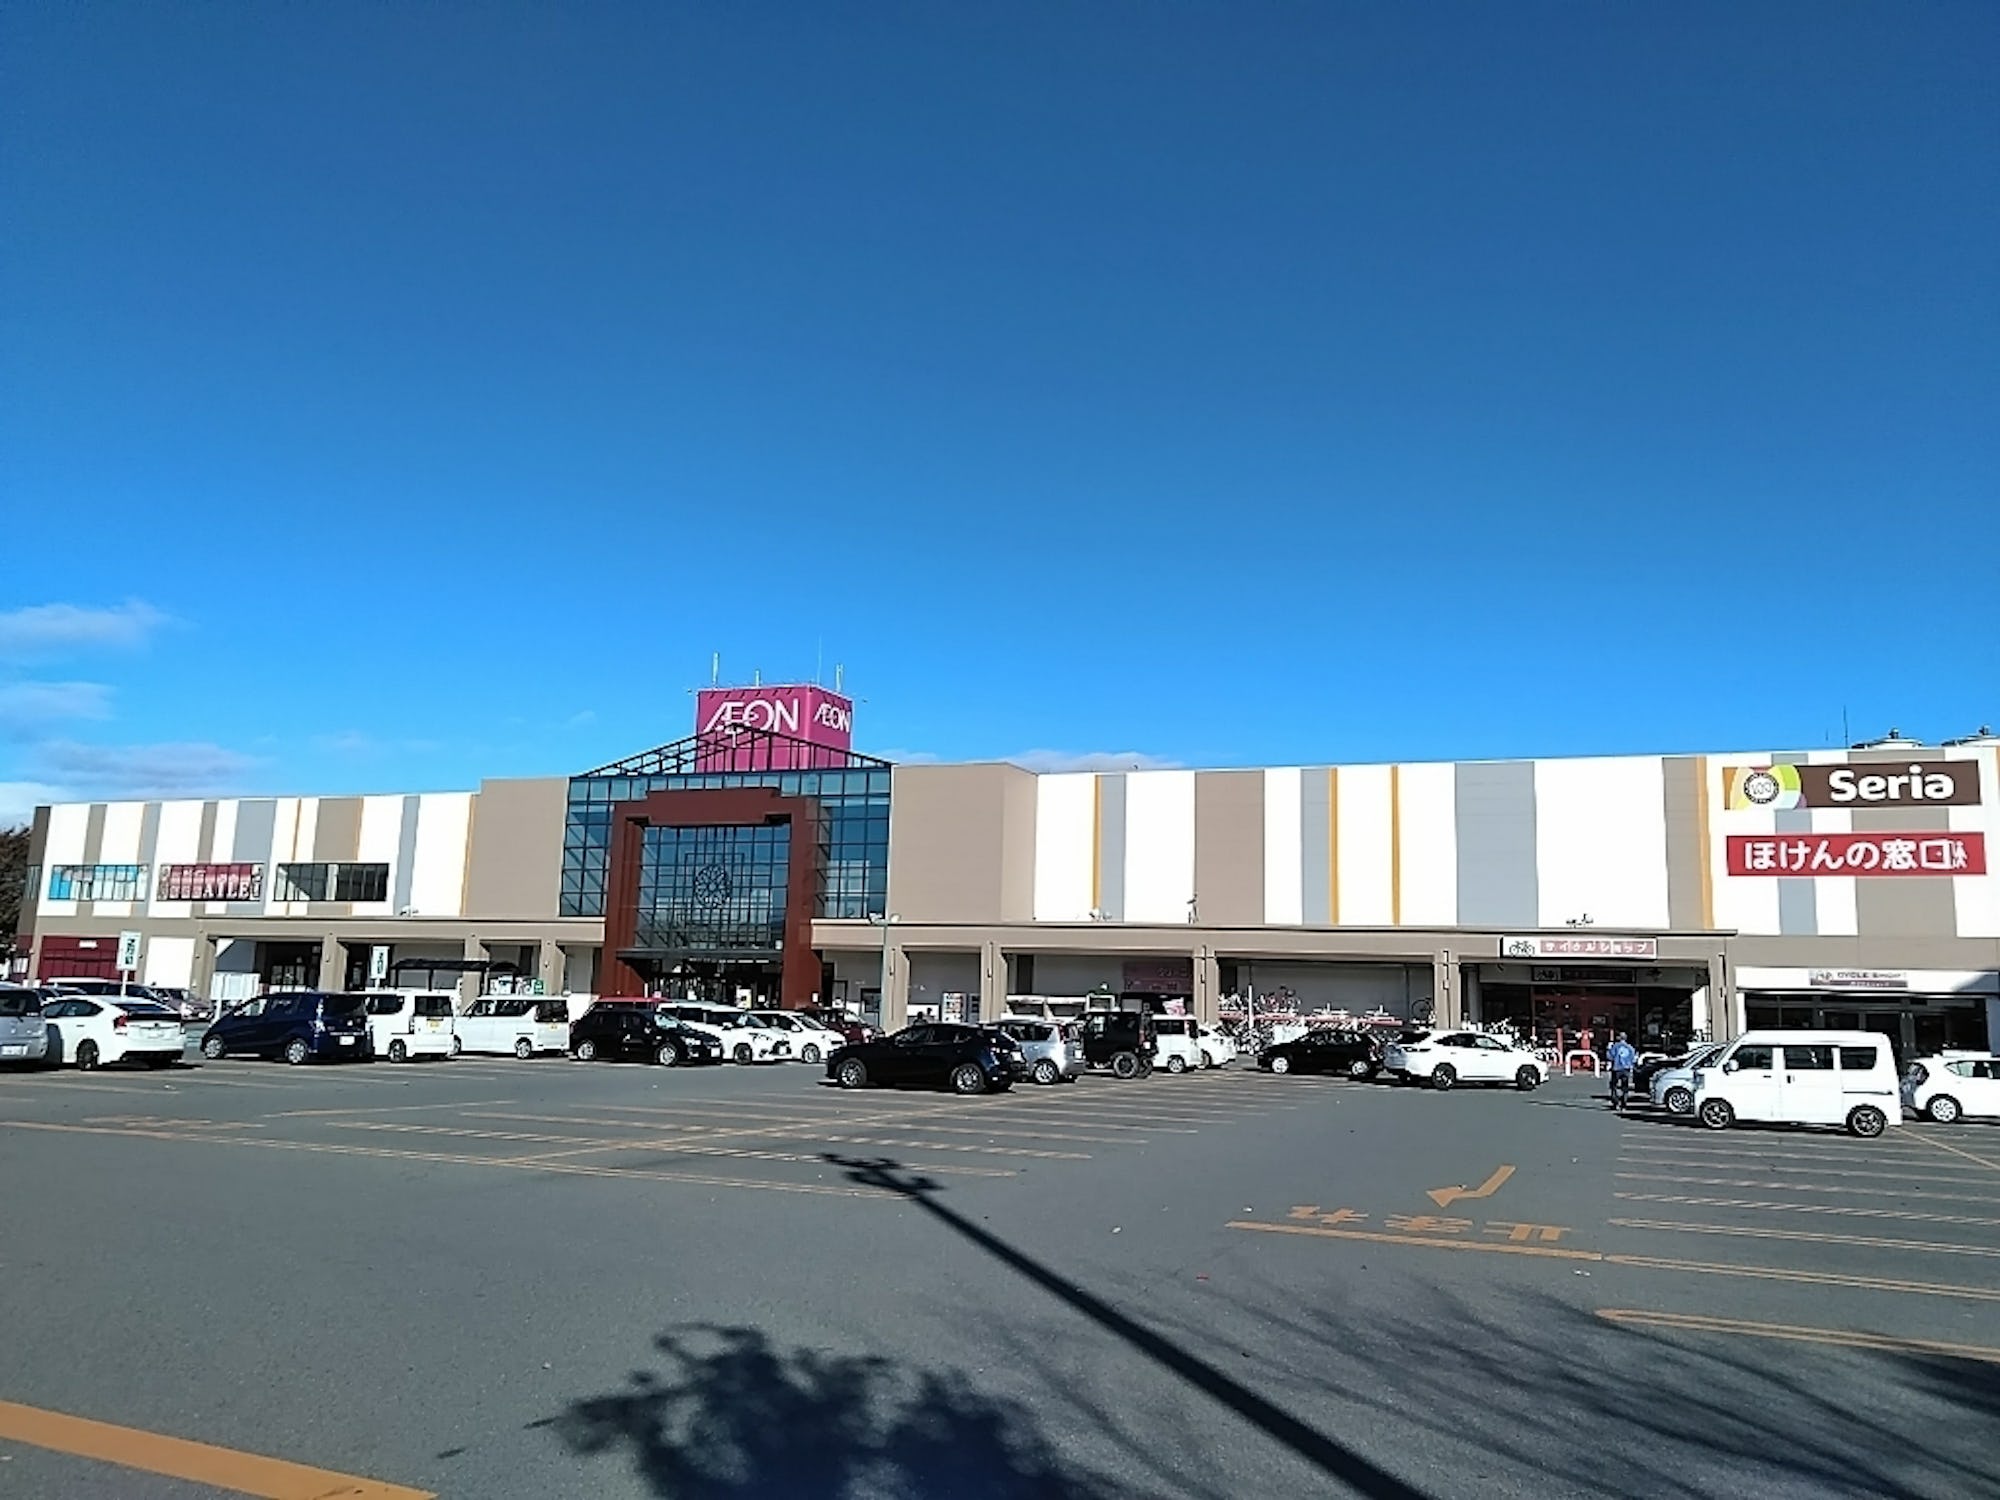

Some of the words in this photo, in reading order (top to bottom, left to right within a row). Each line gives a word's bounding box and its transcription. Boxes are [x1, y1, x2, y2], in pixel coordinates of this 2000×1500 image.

[1828, 764, 1955, 802] Seria
[1744, 838, 1954, 871] ほけんの窓口
[1546, 941, 1647, 954] サイクルショップ
